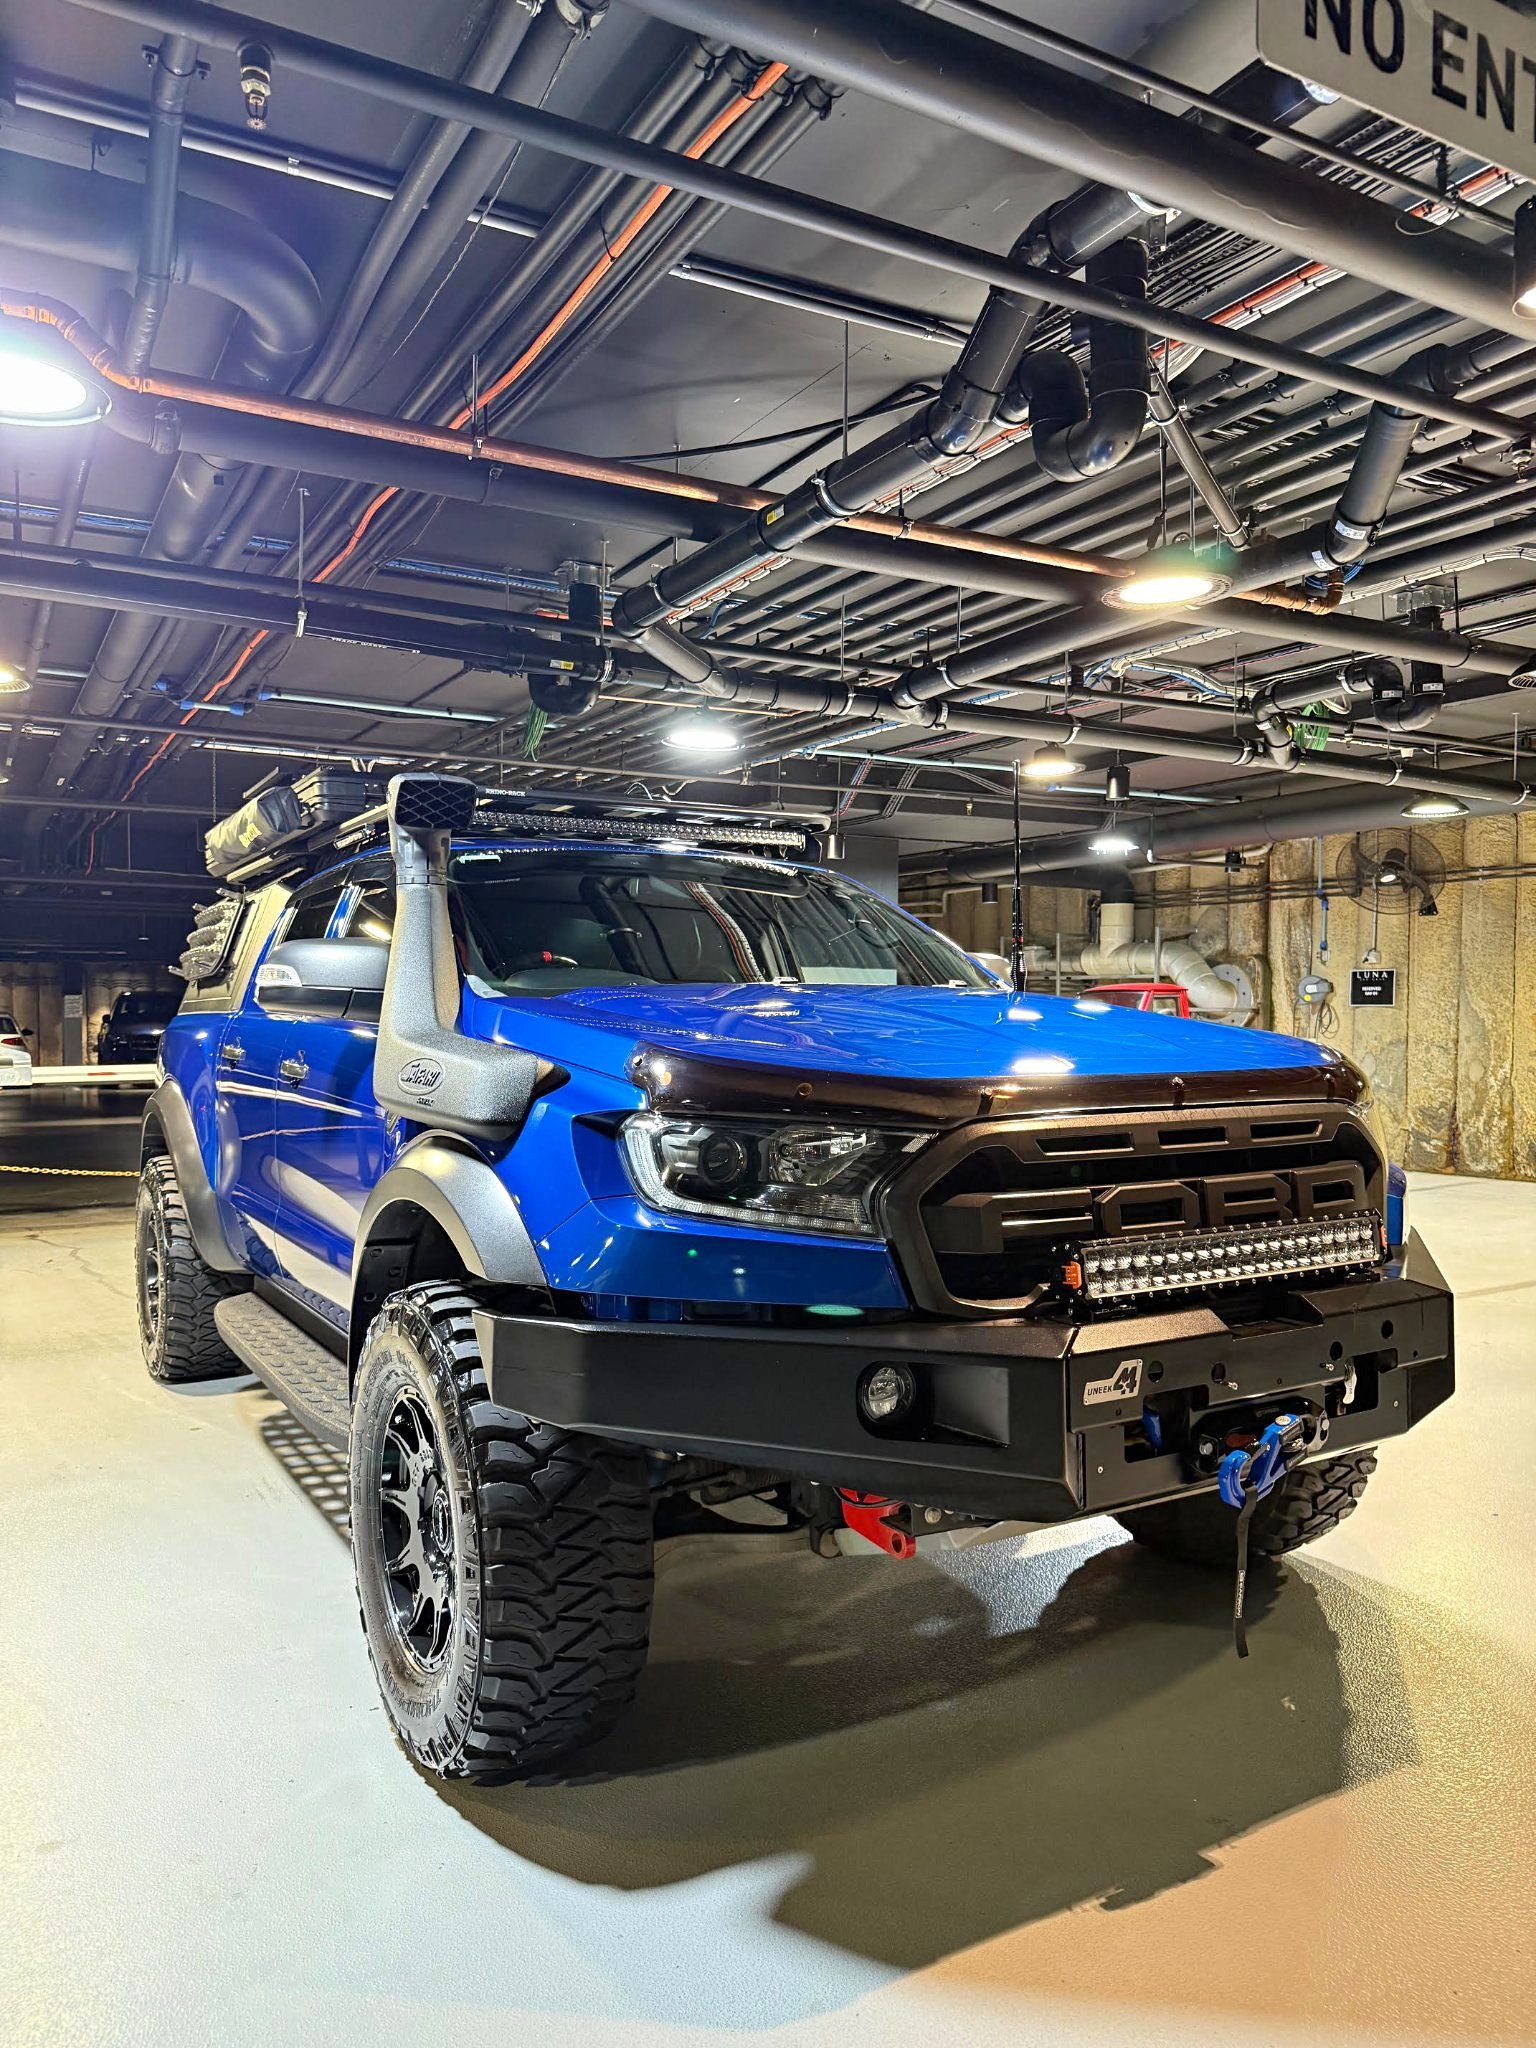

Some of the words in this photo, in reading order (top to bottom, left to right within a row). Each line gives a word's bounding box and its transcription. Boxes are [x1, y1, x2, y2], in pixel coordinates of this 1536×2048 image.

[485, 788, 526, 797] RHINO-RACK
[1356, 971, 1388, 979] LUNA
[960, 1161, 1368, 1253] FORD
[1087, 1384, 1113, 1396] UNEEK
